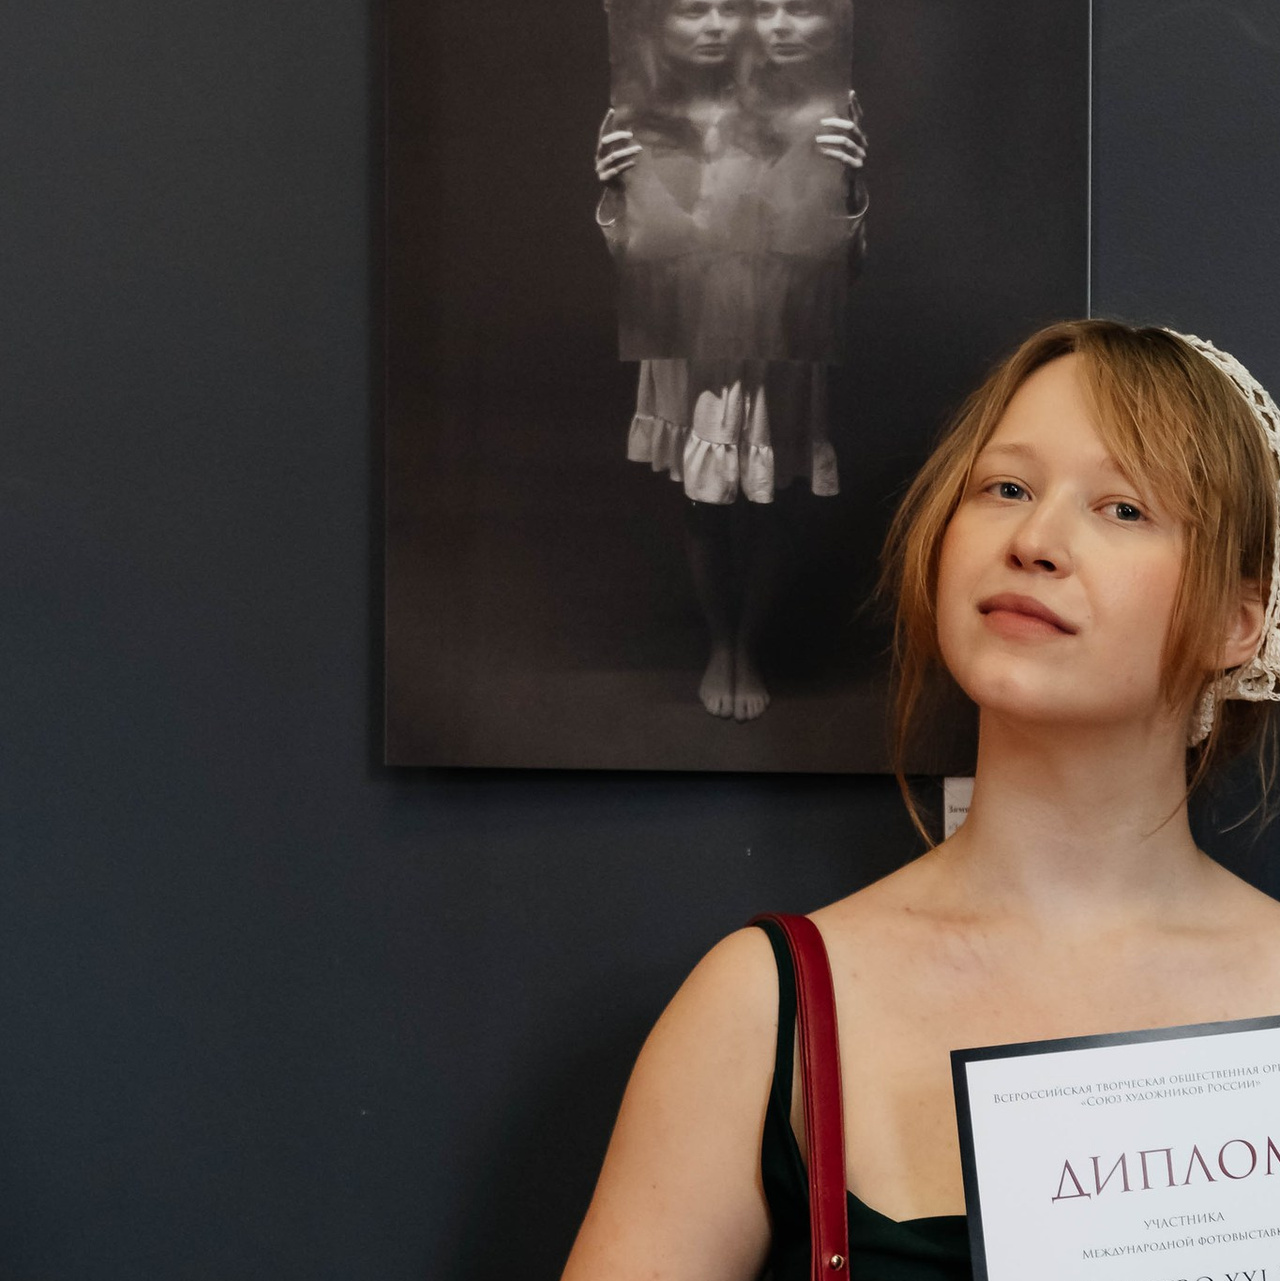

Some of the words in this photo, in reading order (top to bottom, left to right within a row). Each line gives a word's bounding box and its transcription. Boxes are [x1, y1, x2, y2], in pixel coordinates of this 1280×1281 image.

[993, 1085, 1092, 1104] ВСЕРОССИЙСКАЯ
[1096, 1075, 1166, 1093] ТВОРЧЕСКАЯ
[1169, 1066, 1259, 1085] ОБЩЕСТВЕННАЯ
[1080, 1094, 1122, 1107] «СОЮЗ
[1125, 1085, 1204, 1103] ХУДОЖНИКОВ
[1207, 1079, 1261, 1094] РОССИИ»
[1143, 1211, 1225, 1230] УЧАСТНИКА
[1082, 1236, 1195, 1260] МЕЖДУНАРОДНОЙ
